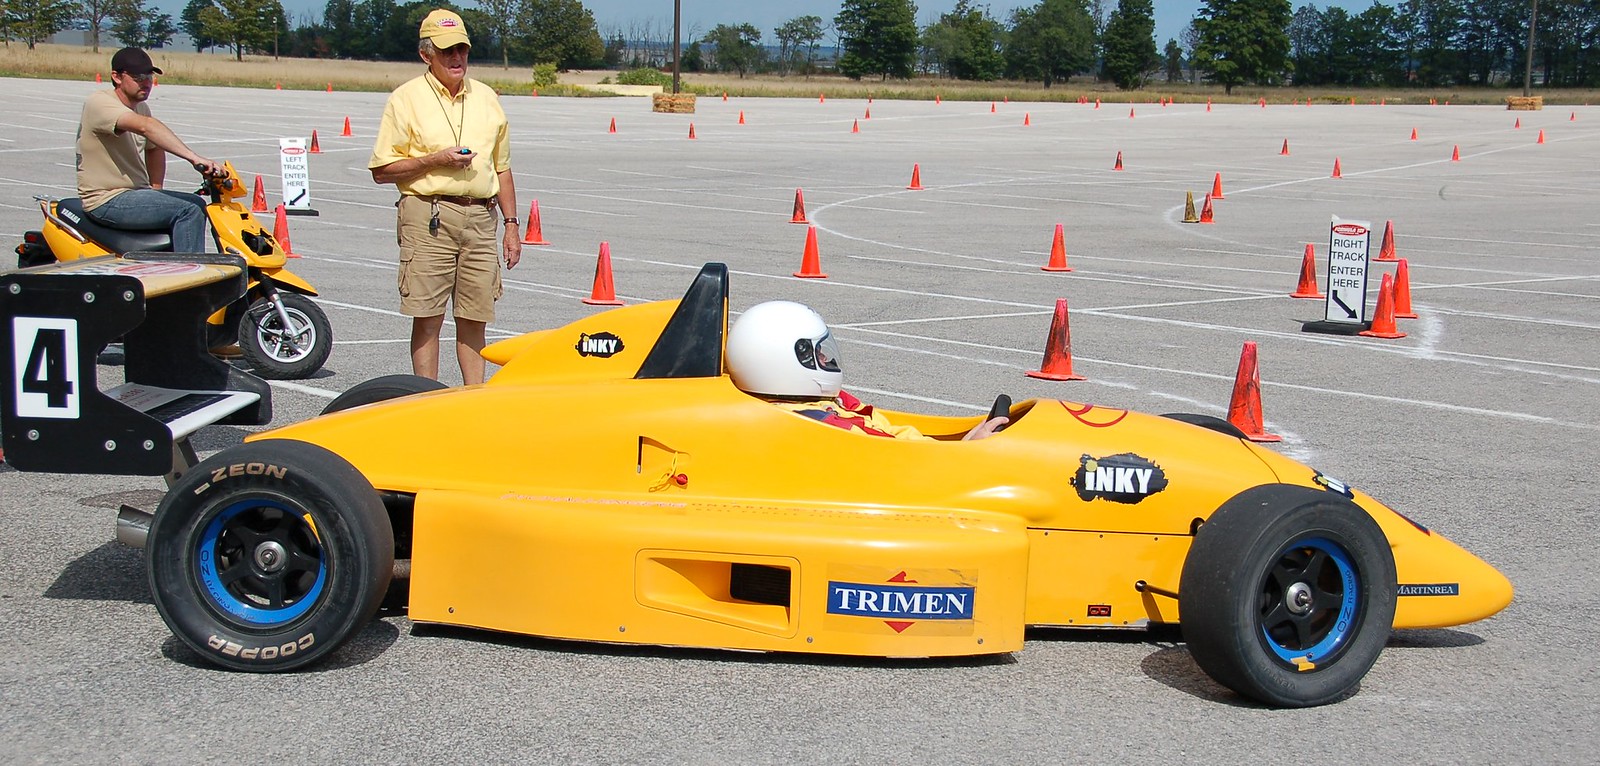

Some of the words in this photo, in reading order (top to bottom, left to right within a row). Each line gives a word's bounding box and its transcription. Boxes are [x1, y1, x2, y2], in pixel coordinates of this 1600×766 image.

[61, 207, 81, 224] YAMAHA
[1333, 238, 1364, 249] RIGHT
[1331, 250, 1365, 262] TRACK
[1330, 265, 1364, 276] ENTER
[1332, 278, 1360, 289] HERE
[22, 328, 73, 408] 4
[211, 462, 287, 483] ZEON
[1397, 585, 1454, 595] MARTINREA
[835, 587, 968, 614] TRIMEN
[208, 632, 315, 660] COOPER
